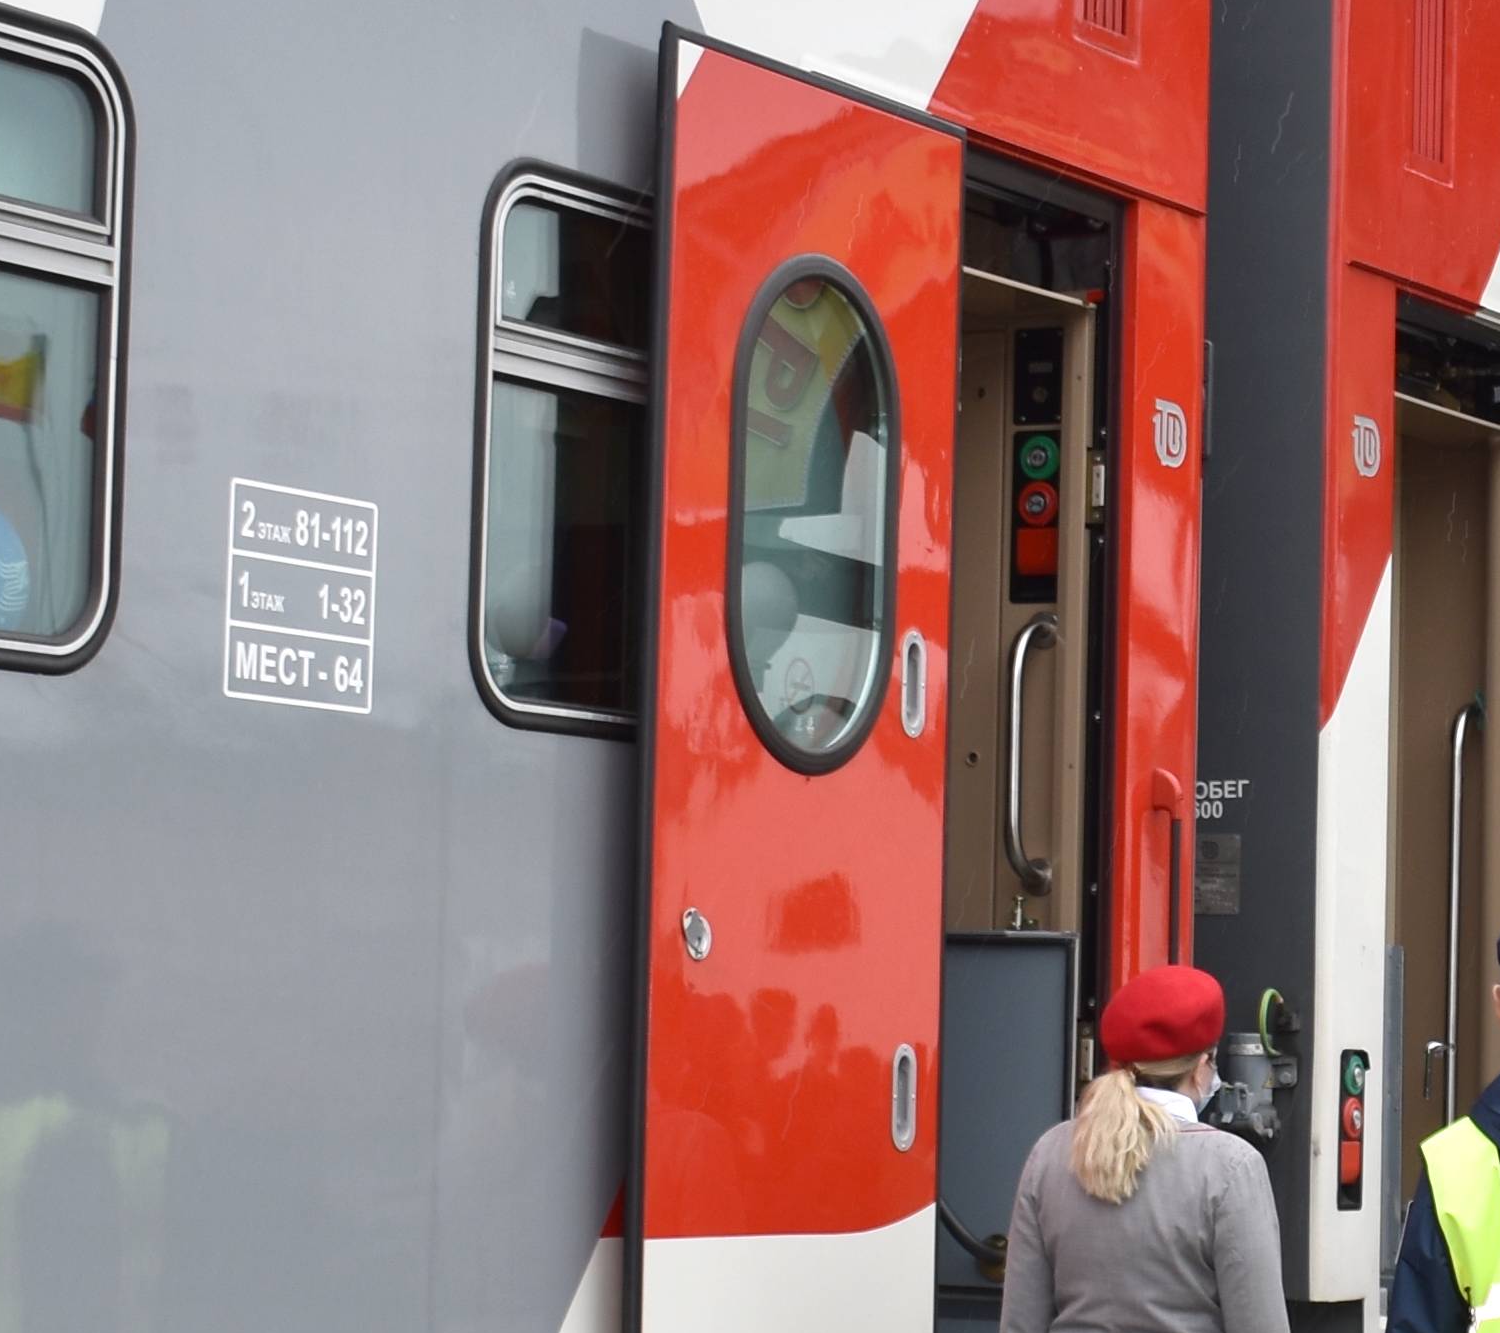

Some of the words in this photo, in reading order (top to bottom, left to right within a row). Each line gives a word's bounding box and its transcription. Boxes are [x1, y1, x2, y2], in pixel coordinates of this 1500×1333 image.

[241, 500, 256, 539] 2
[257, 521, 292, 545] ЭТАЖ
[295, 509, 369, 557] 81-112
[239, 570, 250, 608] 1
[250, 591, 285, 614] ЭТАЖ
[318, 583, 366, 626] 1-32
[235, 641, 316, 688] МЕСТ
[334, 655, 364, 695] 64
